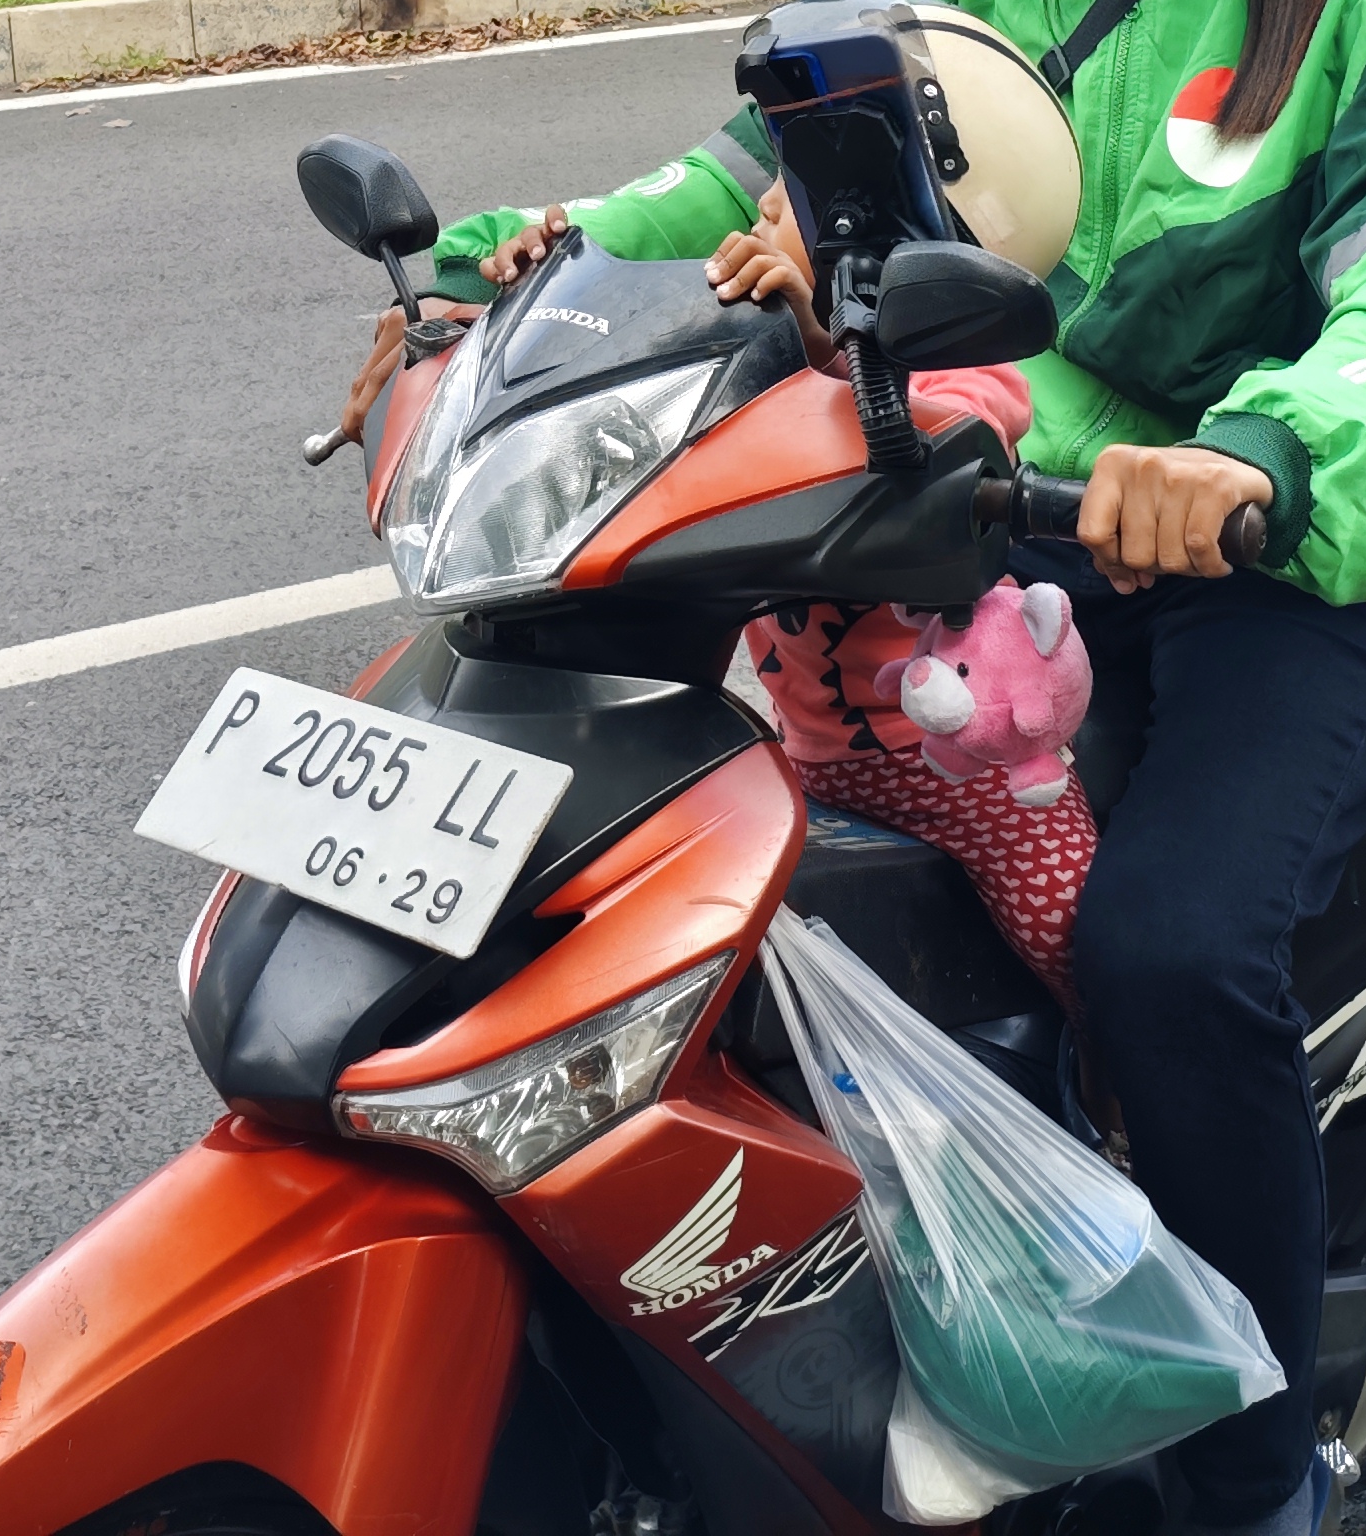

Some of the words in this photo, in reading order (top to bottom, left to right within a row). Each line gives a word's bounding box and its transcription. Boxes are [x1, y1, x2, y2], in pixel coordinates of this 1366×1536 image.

[521, 307, 610, 337] HONDA
[206, 690, 260, 754] P
[262, 710, 427, 811] 2055
[433, 759, 518, 849] LL
[629, 1243, 780, 1316] HONDA
